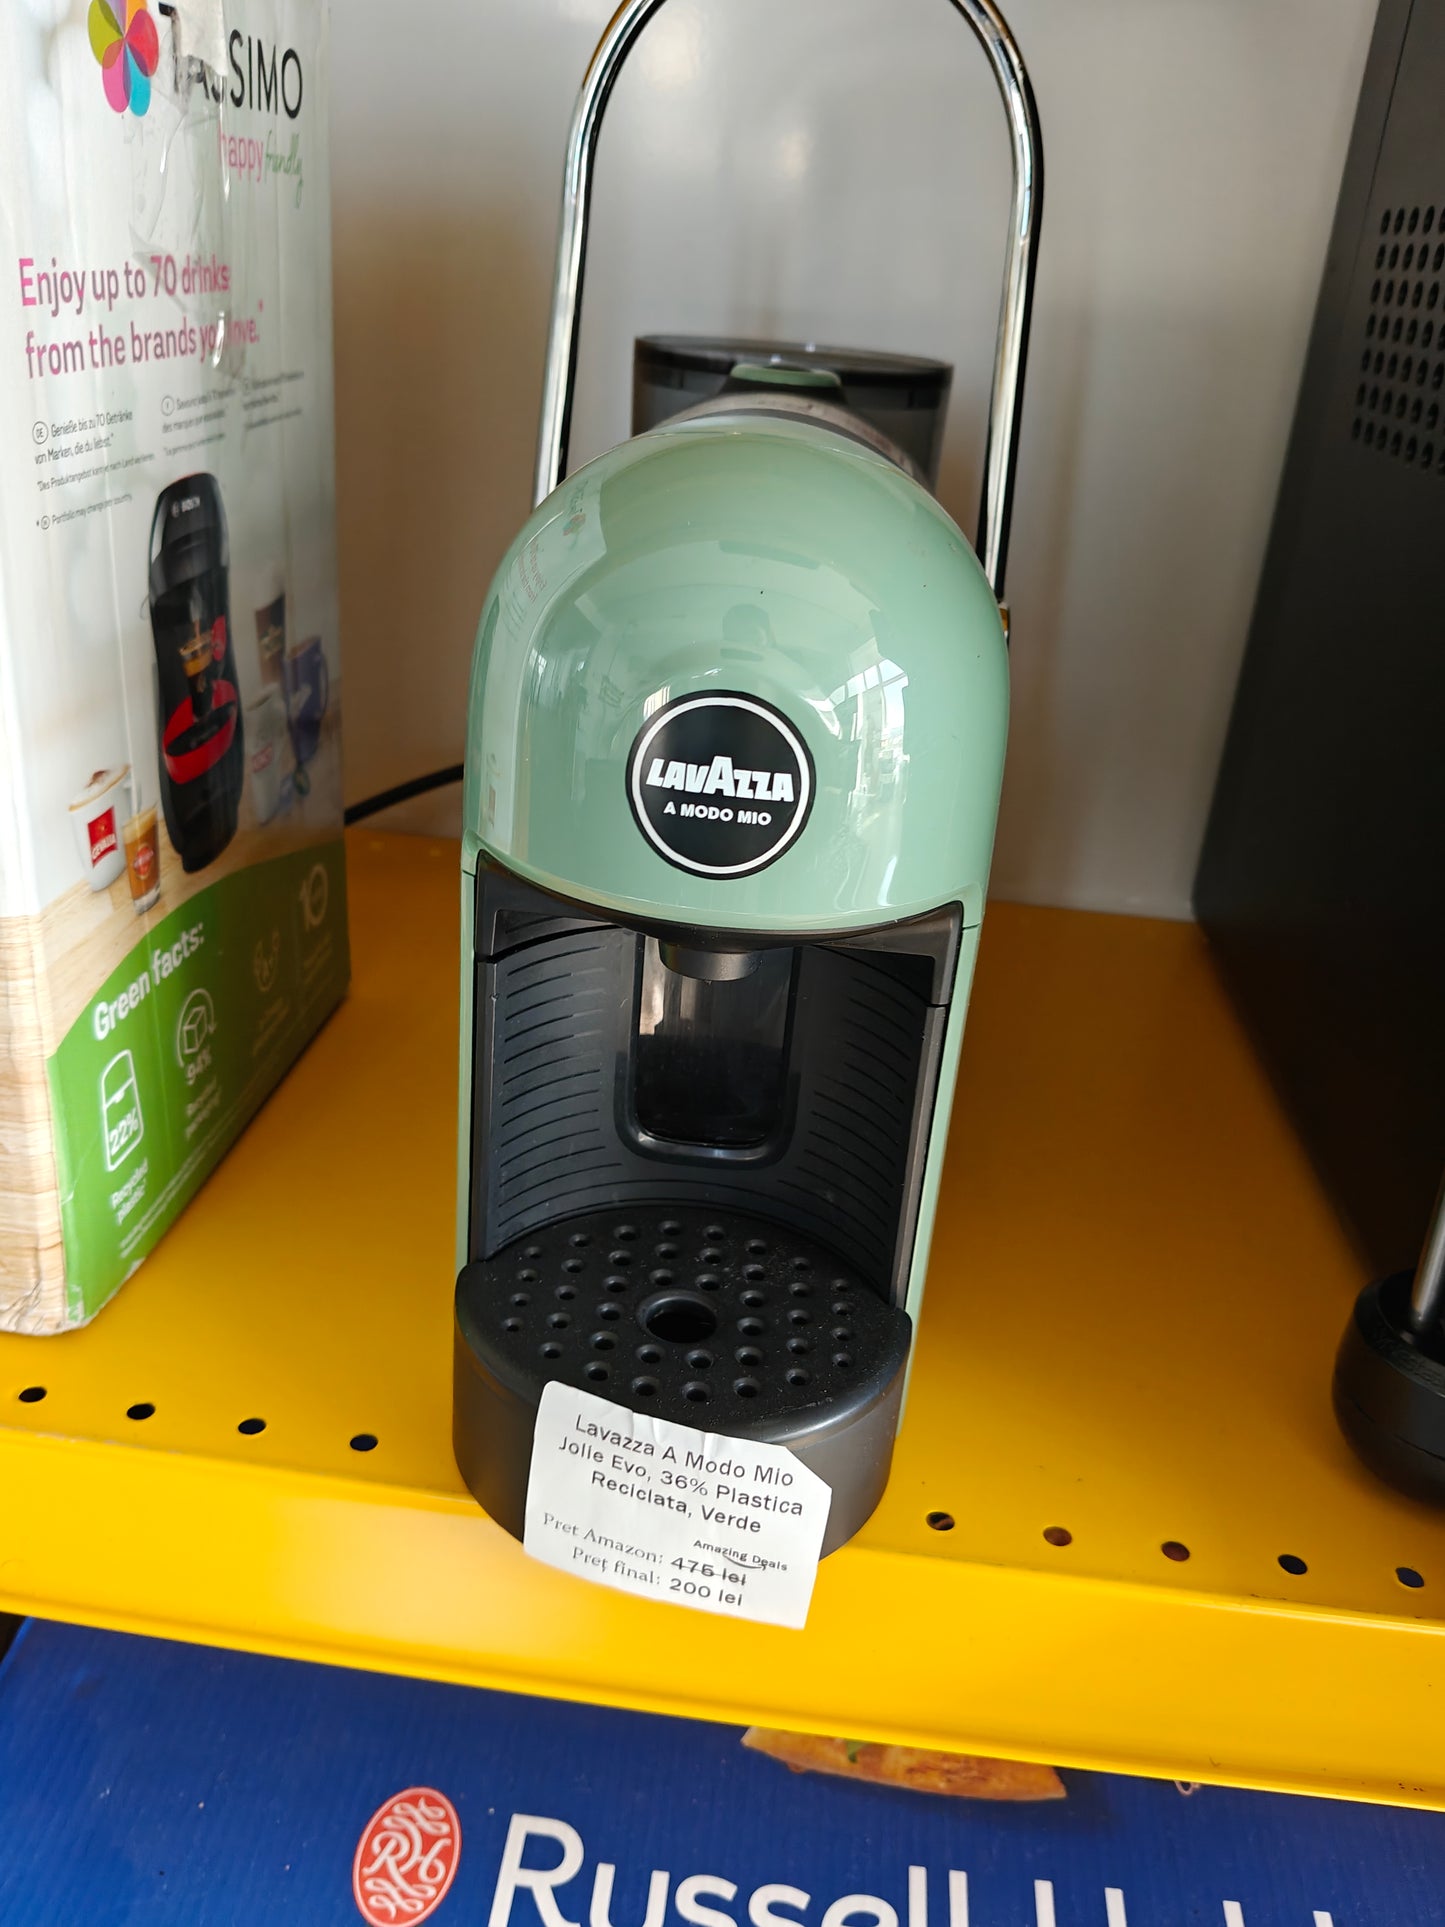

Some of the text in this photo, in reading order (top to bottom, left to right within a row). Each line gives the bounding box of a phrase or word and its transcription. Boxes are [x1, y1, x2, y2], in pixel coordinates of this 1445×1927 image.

[19, 253, 230, 317] Enjoy up to 70 drinks
[25, 330, 85, 379] from
[88, 323, 126, 369] the
[130, 316, 197, 363] brands
[199, 322, 226, 364] yo
[646, 756, 794, 802] LAVAZZA
[663, 801, 772, 826] A MODO MIO
[94, 922, 205, 1041] Green facts:
[109, 1106, 139, 1156] 22%
[575, 1414, 794, 1487] Lavazza A Modo Mio
[591, 1470, 761, 1533] Reciclata, Verde
[611, 1454, 651, 1482] Evo,
[660, 1470, 708, 1497] 36%
[716, 1484, 804, 1516] Plastica
[583, 1527, 663, 1564] Amazon:
[670, 1557, 716, 1577] 475
[693, 1539, 788, 1572] Amazing Deals
[613, 1559, 660, 1585] final:
[669, 1577, 711, 1598] 200
[718, 1589, 742, 1606] lei
